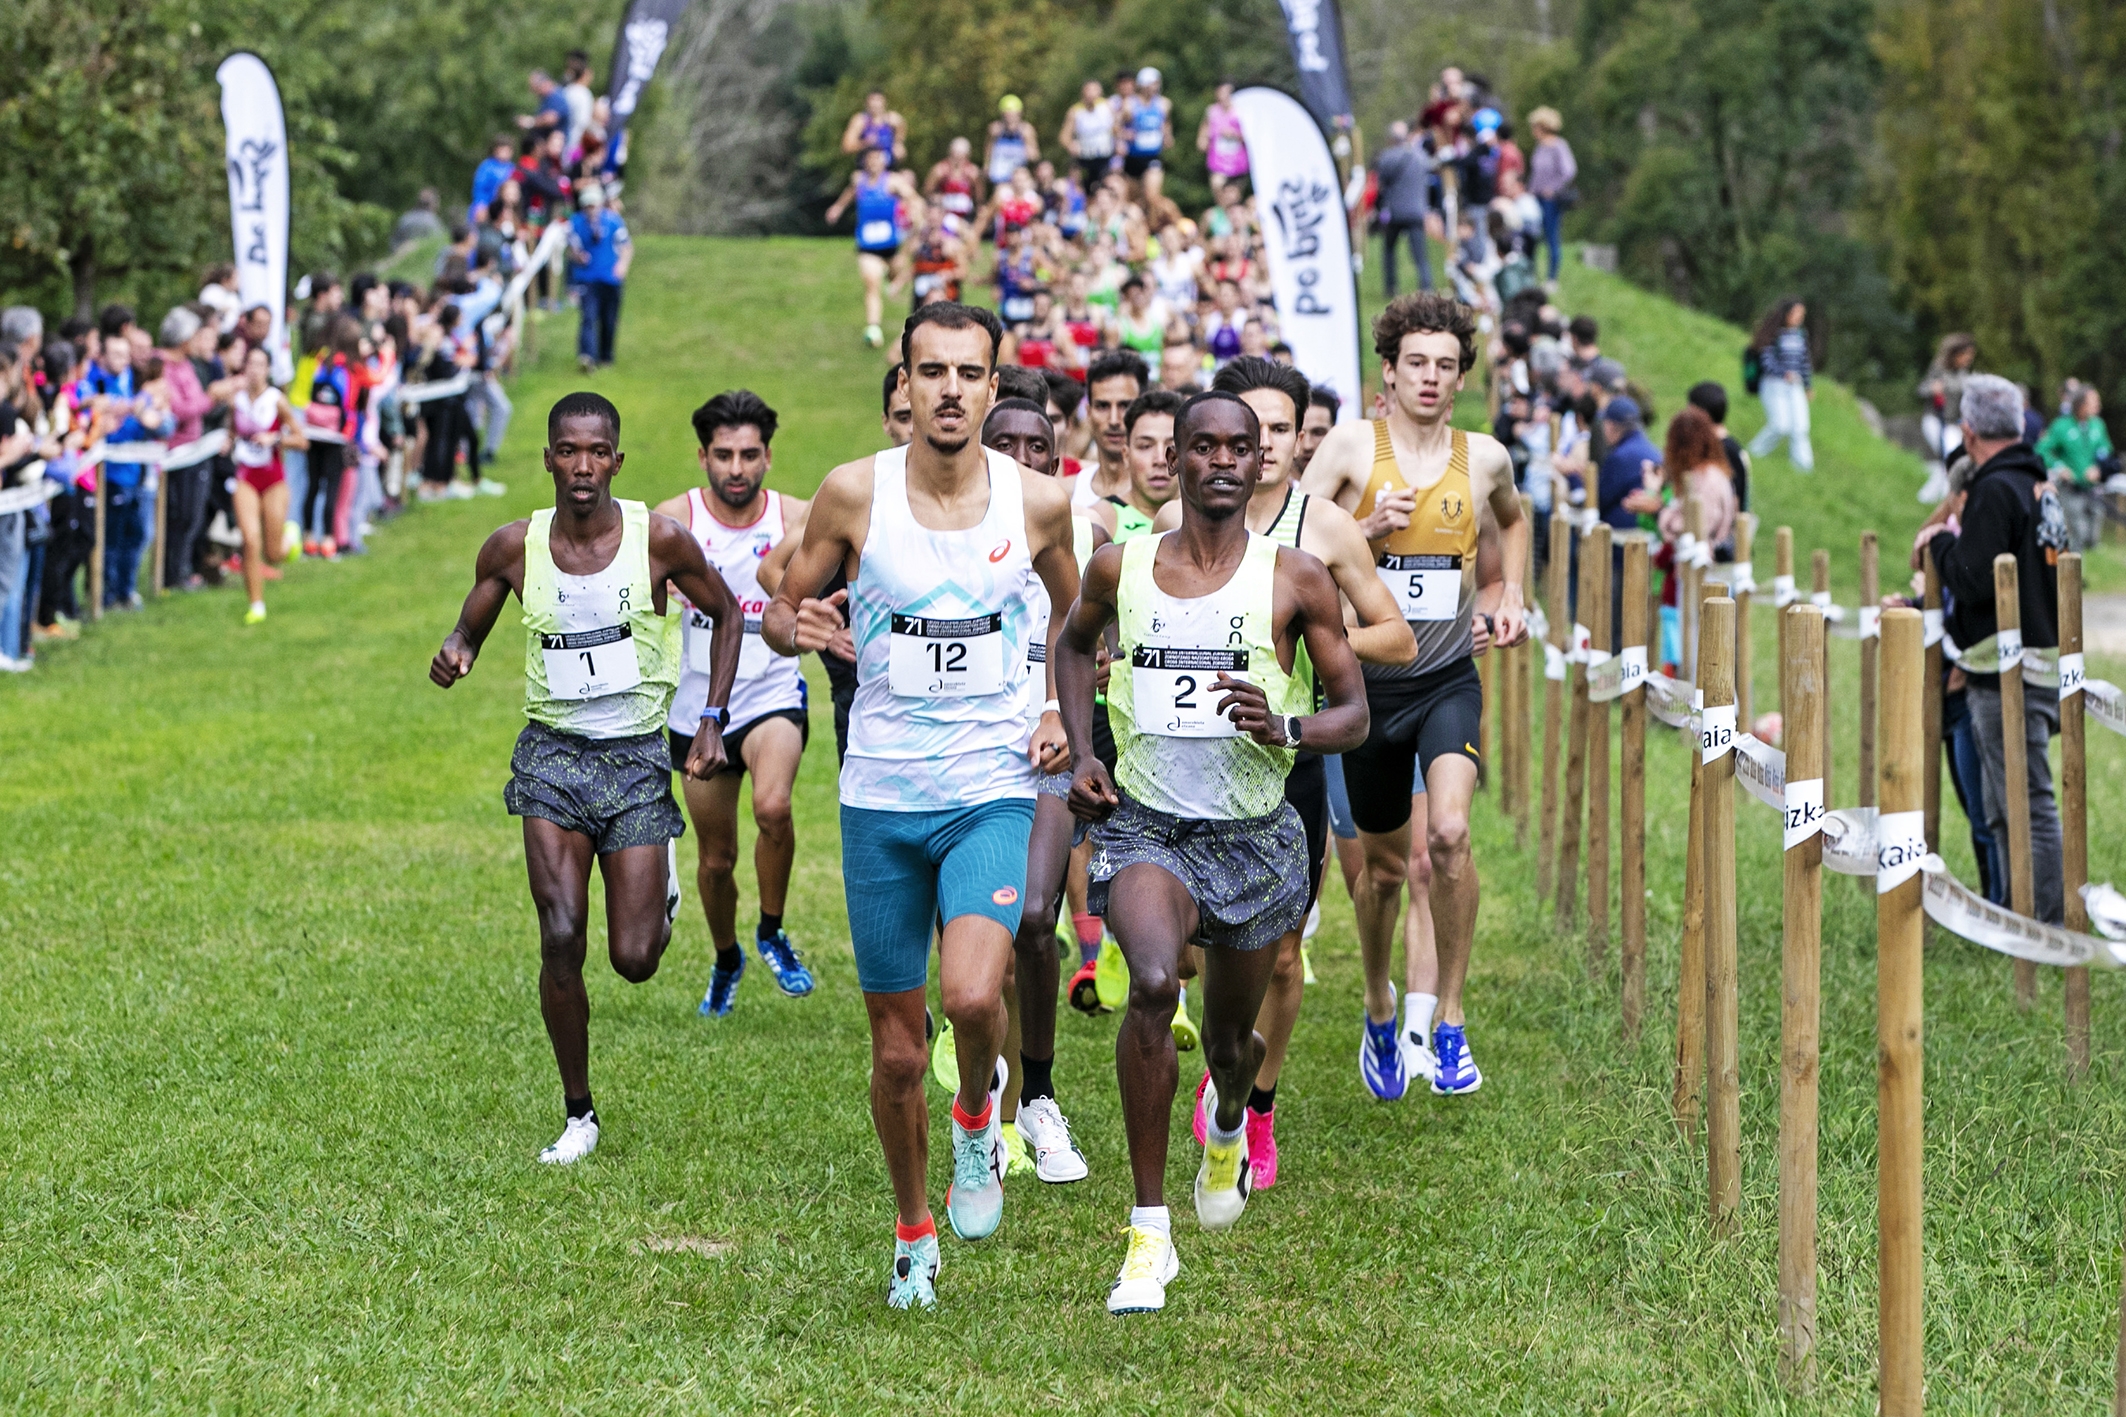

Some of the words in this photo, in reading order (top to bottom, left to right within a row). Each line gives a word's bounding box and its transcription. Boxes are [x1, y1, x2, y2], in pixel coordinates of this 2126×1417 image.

[1386, 554, 1401, 570] 71
[1408, 574, 1424, 599] 5
[904, 616, 922, 636] 71
[547, 634, 564, 649] 71
[579, 651, 596, 677] 1
[926, 642, 968, 673] 12
[1142, 648, 1161, 668] 71
[1174, 675, 1197, 709] 2
[1703, 725, 1731, 749] aia
